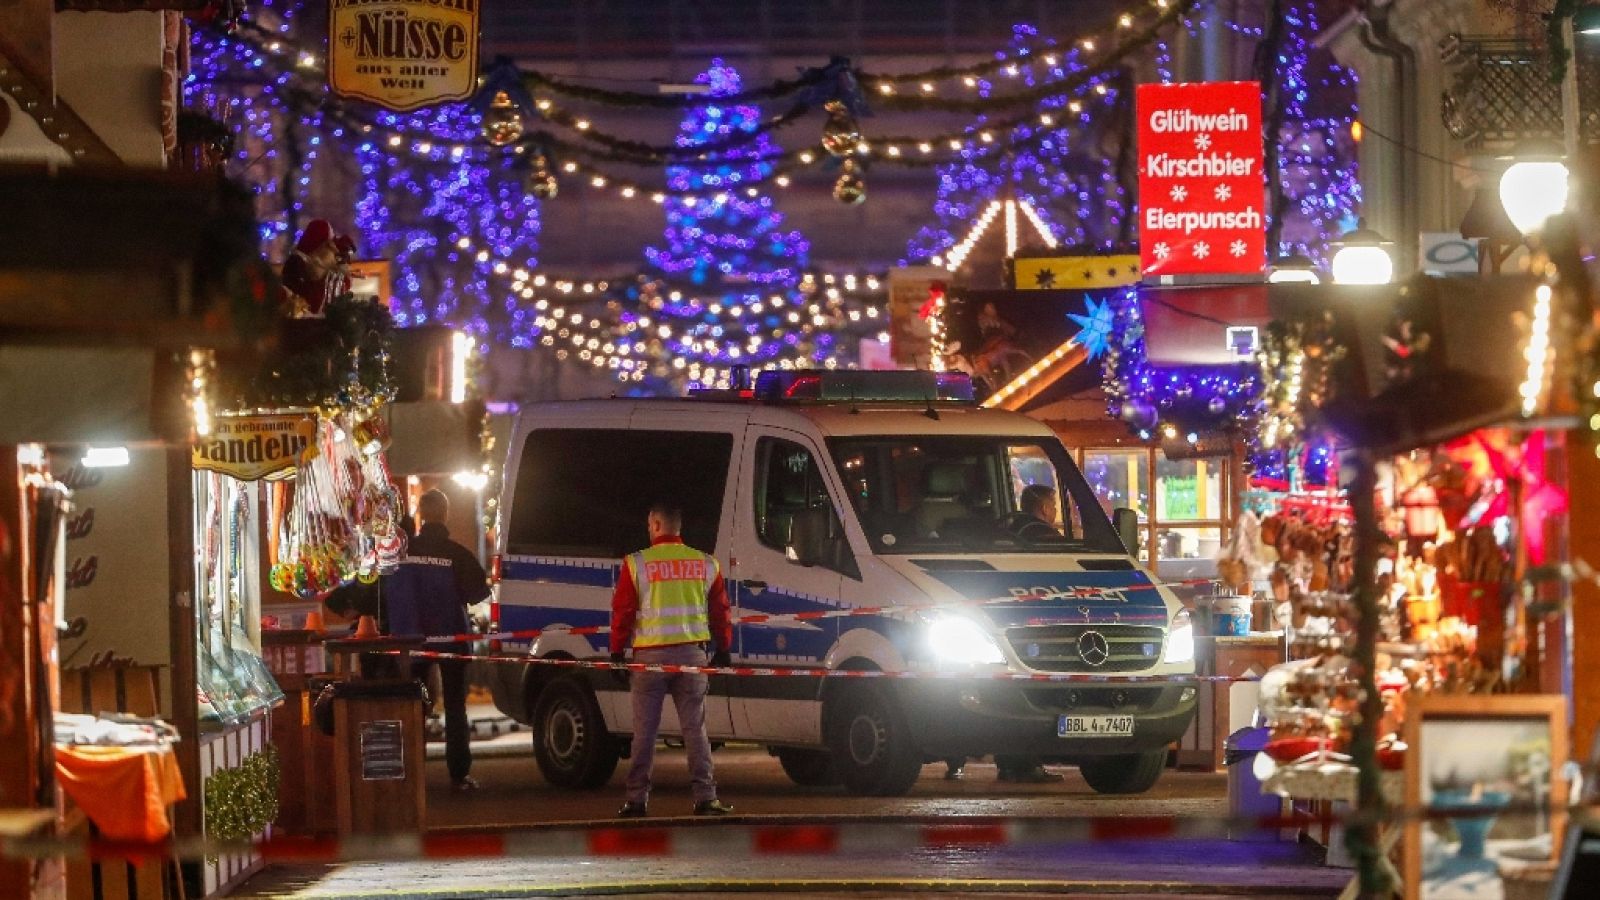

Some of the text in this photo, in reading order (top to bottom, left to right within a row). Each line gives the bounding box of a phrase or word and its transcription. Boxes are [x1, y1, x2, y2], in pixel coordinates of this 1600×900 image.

[356, 64, 449, 76] aus aller
[381, 77, 424, 89] Welt
[1150, 108, 1248, 133] Glühwein
[1147, 152, 1255, 177] Kirschbier
[1146, 206, 1260, 235] Eierpunsch
[1066, 718, 1088, 732] BBL
